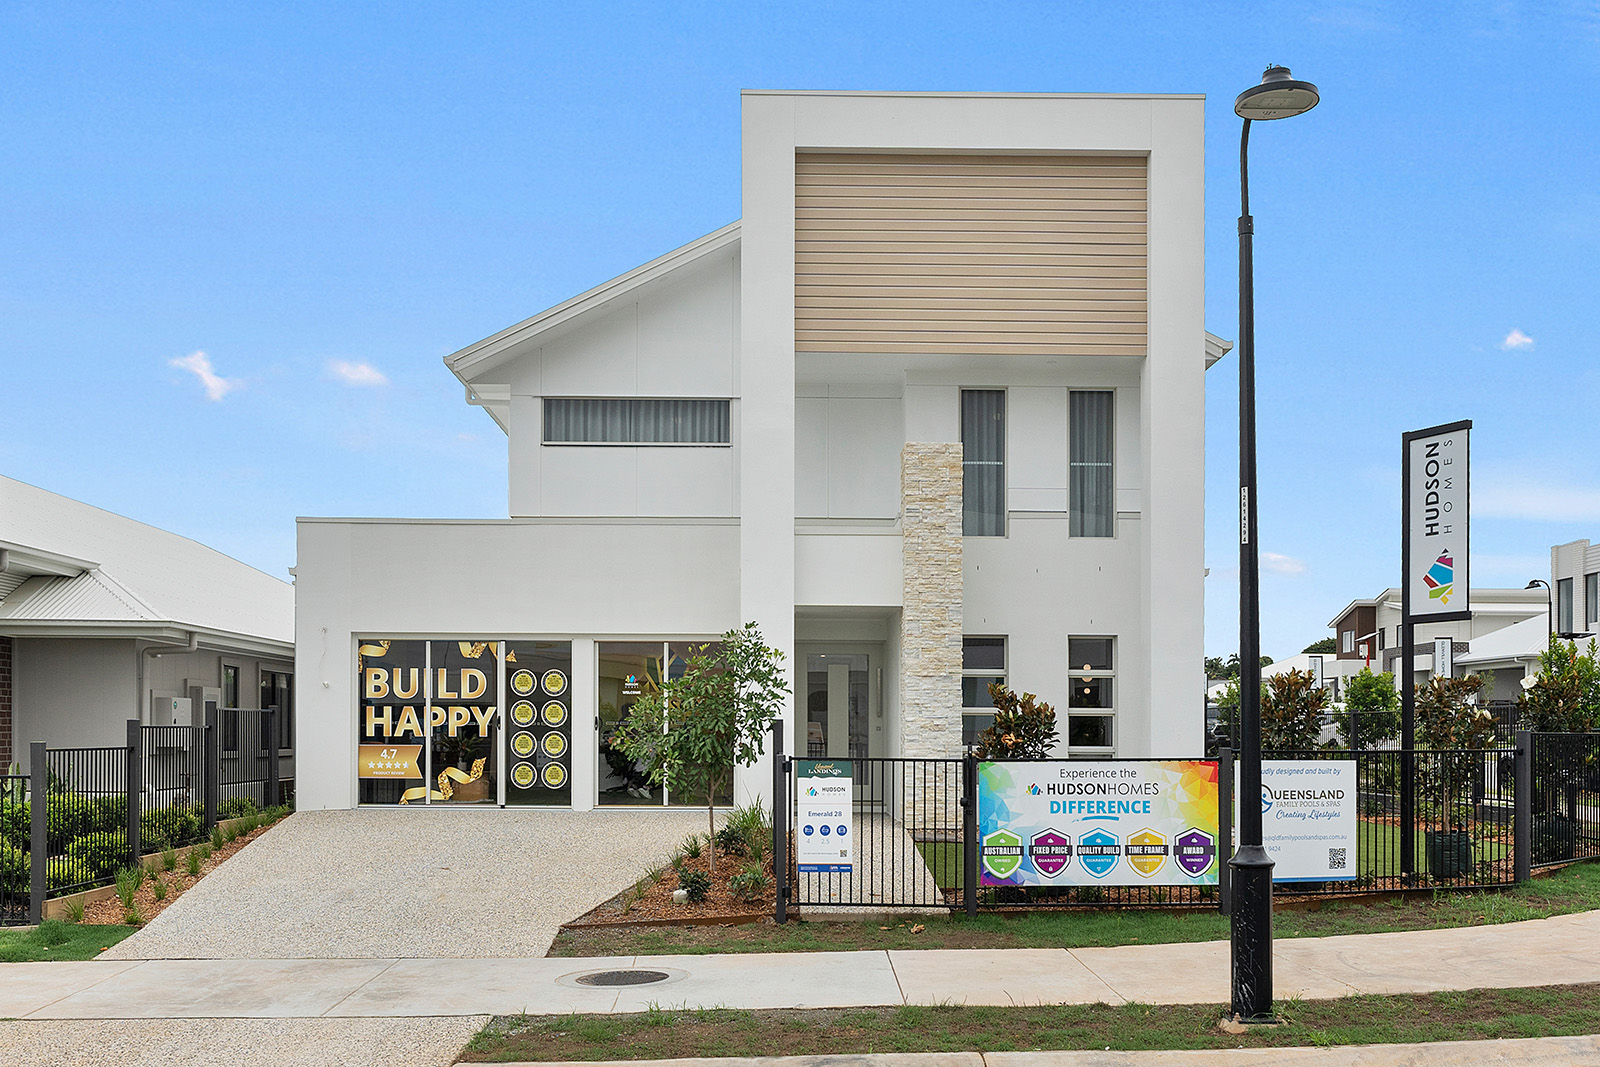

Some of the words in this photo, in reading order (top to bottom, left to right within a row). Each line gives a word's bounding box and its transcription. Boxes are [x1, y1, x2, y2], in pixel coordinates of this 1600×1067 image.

[1425, 442, 1440, 537] HUDSON
[1444, 439, 1453, 534] HOMES
[366, 667, 487, 699] BUILD
[366, 706, 497, 737] HAPPY
[380, 749, 398, 759] 4.7
[1060, 768, 1116, 780] Experience
[1120, 768, 1136, 778] the
[1261, 768, 1275, 776] udly
[1276, 768, 1304, 776] designed
[1333, 768, 1341, 776] by
[1047, 782, 1159, 795] HUDSONHOMES
[1050, 800, 1150, 814] DIFFERENCE
[1276, 810, 1306, 820] Creating
[1308, 810, 1341, 820] Lifestyles
[984, 846, 1020, 855] AUSTRALIAN
